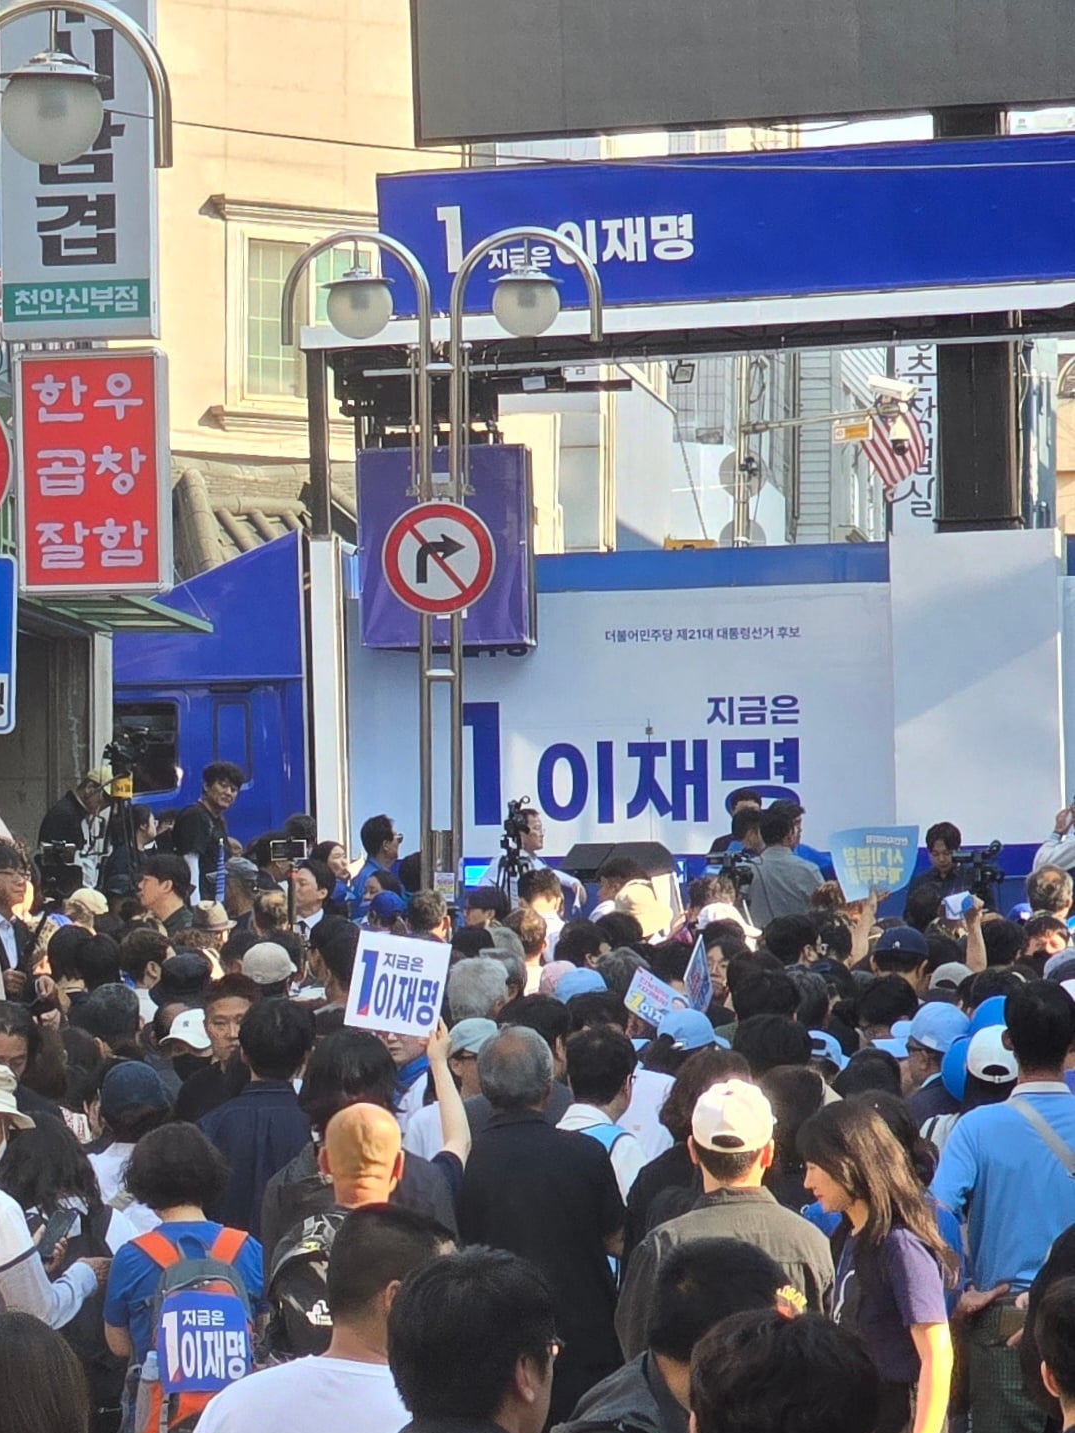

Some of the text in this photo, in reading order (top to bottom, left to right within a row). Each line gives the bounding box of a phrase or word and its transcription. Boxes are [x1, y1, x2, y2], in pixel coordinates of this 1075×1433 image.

[436, 205, 695, 273] 1 지금은 이재명
[14, 285, 140, 316] 천안신부점
[31, 372, 144, 424] 한우
[36, 444, 147, 497] 곱창
[35, 517, 149, 570] 잘함
[605, 626, 801, 643] 더불어민주당 제21대 대통령선거 후보
[706, 694, 800, 726] 지금은
[463, 701, 801, 826] 1 이재명
[357, 949, 441, 1026] 1 이재명
[382, 952, 425, 973] 지금은
[182, 1309, 225, 1327] 지금은
[162, 1311, 247, 1383] 1 이재명
